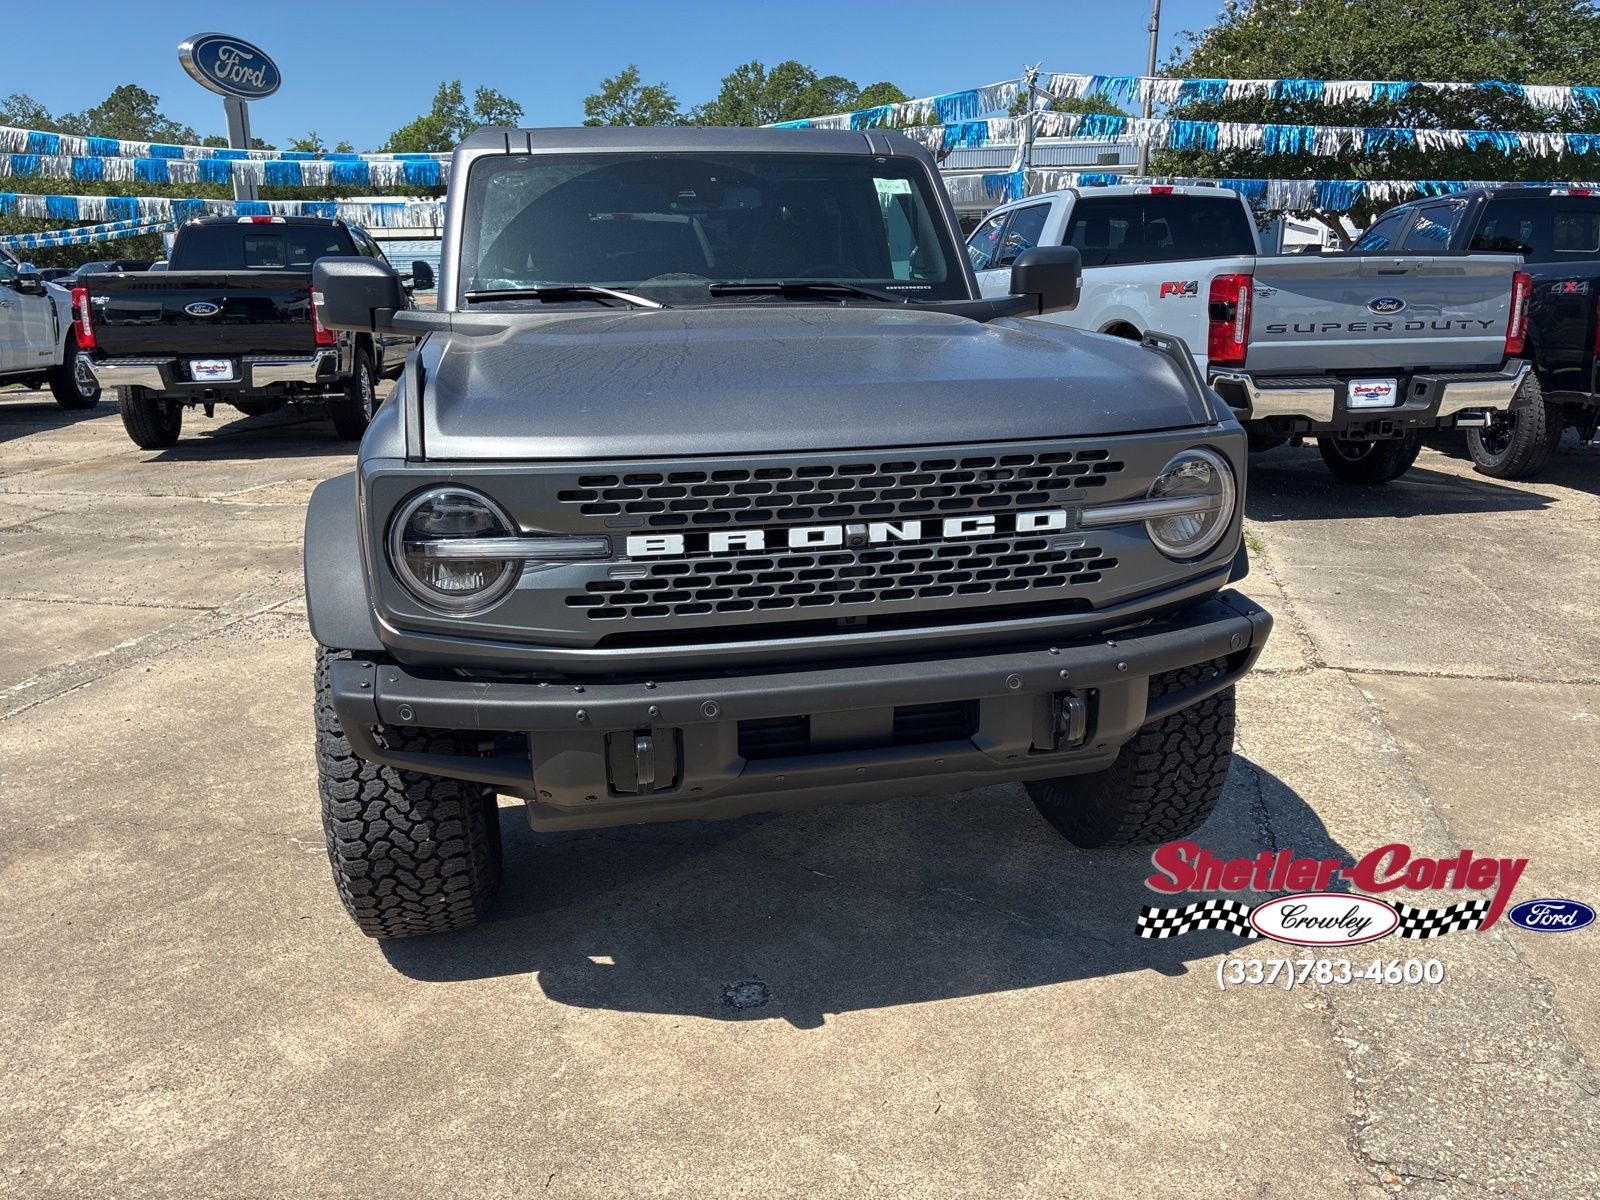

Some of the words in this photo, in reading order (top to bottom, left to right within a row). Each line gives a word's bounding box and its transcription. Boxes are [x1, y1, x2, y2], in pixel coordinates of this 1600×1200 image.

[214, 46, 267, 88] Ford
[1160, 281, 1199, 298] FX4
[1376, 299, 1399, 311] Ford
[1266, 321, 1394, 335] SUPER
[1404, 319, 1495, 332] DUTY
[626, 509, 1068, 557] BRONCO
